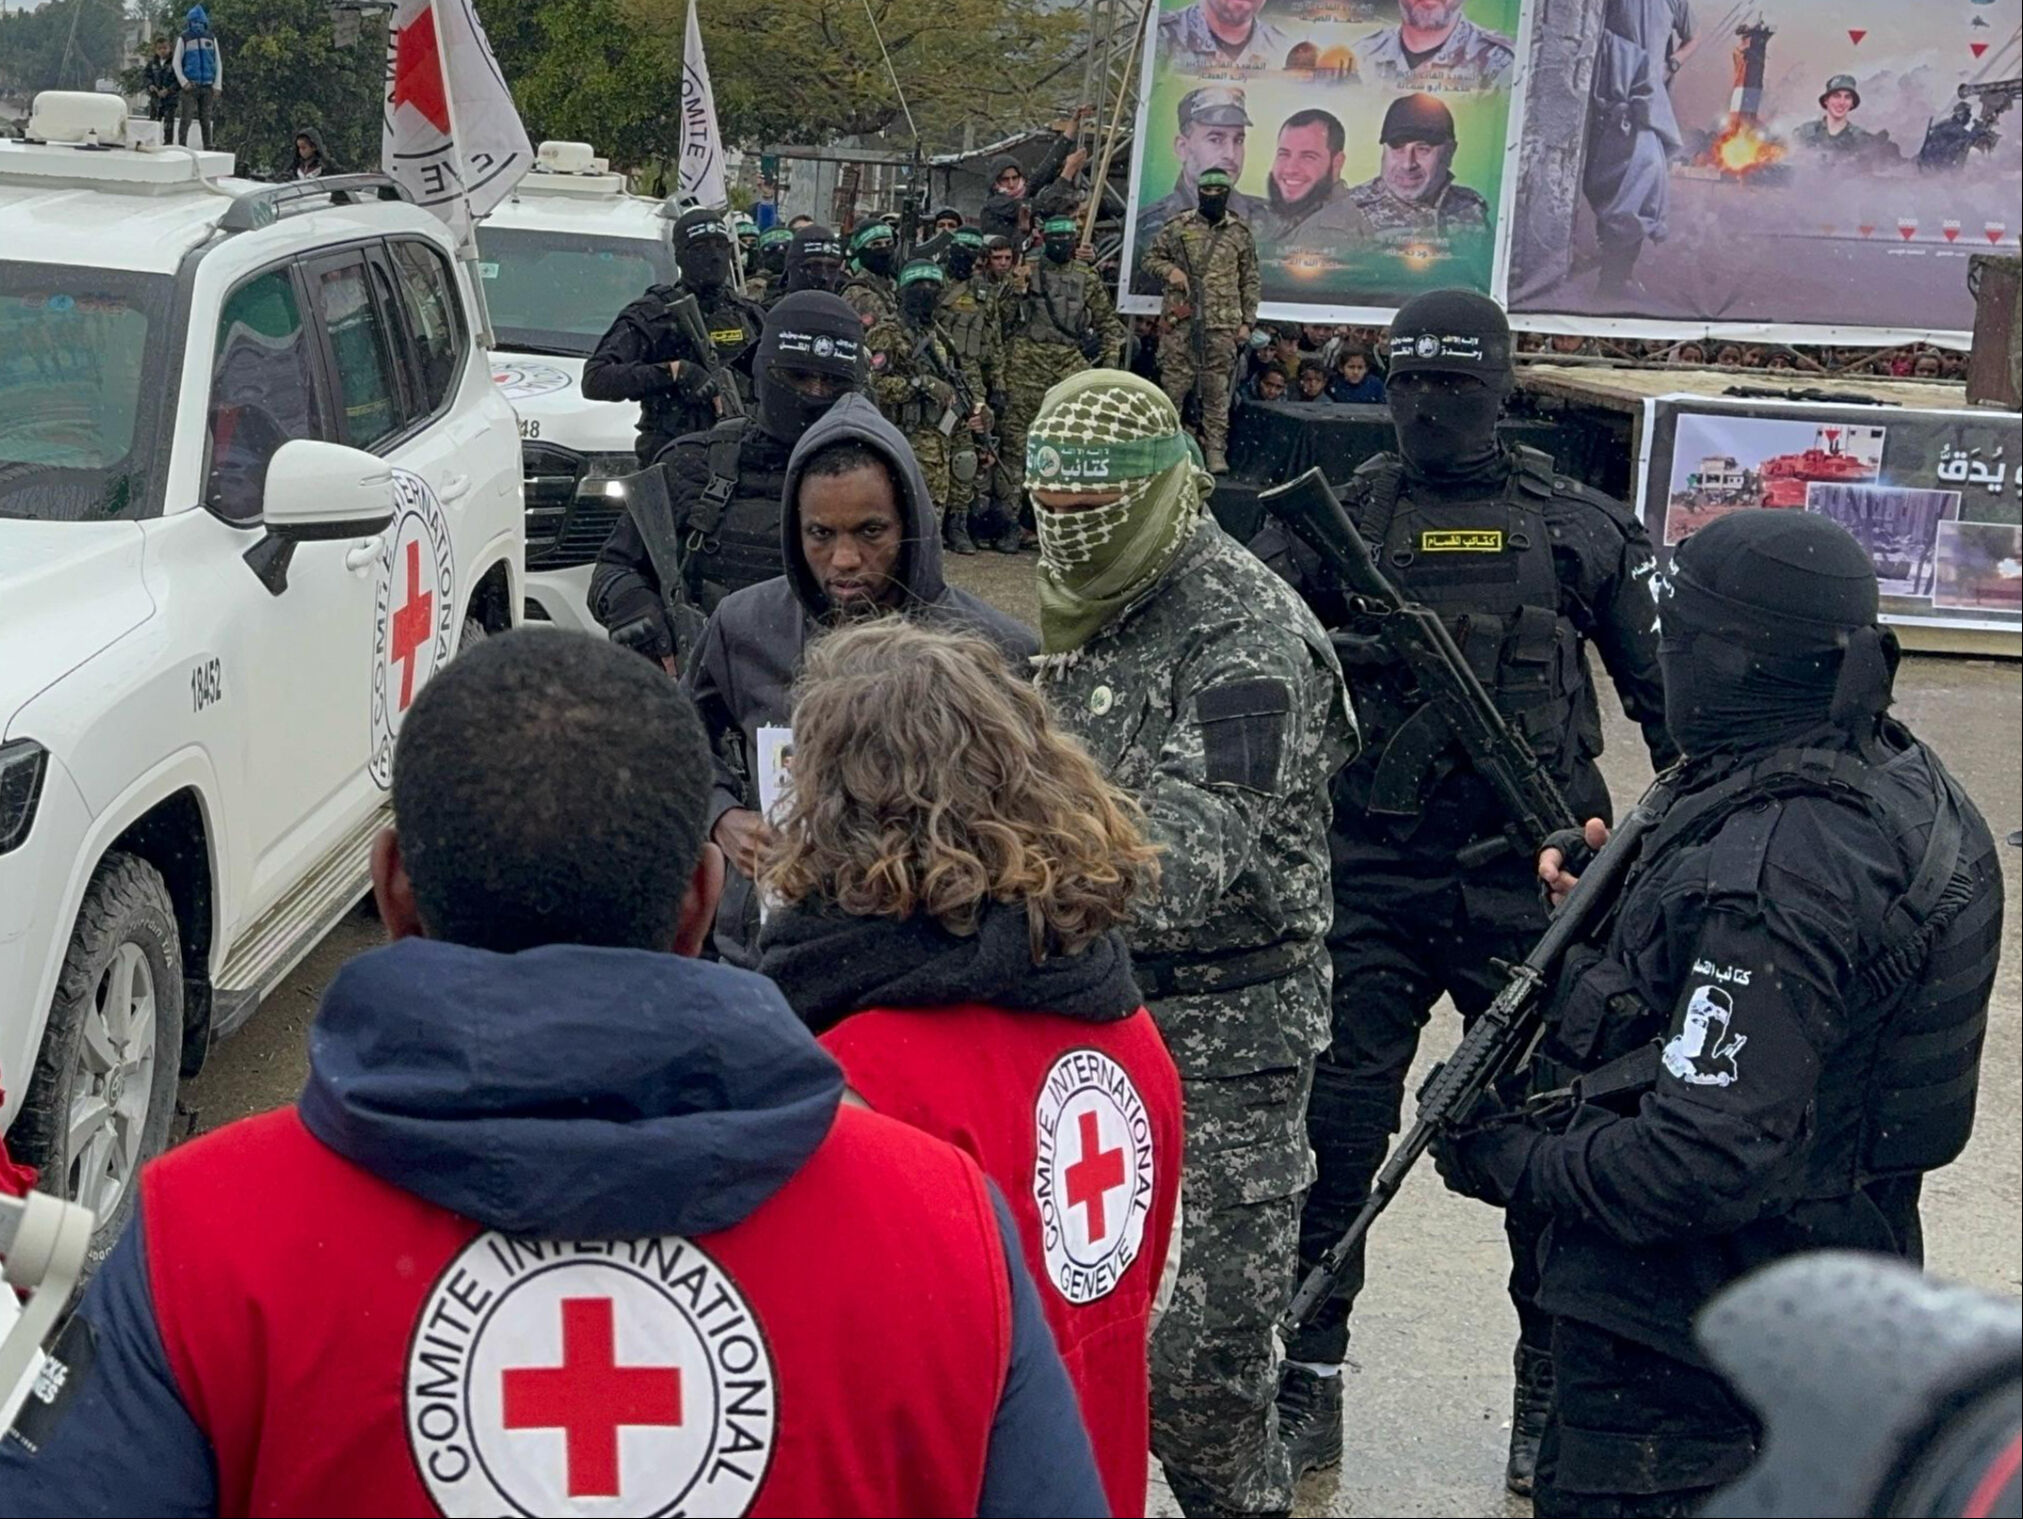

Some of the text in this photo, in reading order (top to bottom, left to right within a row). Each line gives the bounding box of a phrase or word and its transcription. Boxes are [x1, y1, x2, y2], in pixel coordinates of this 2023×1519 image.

[681, 79, 708, 159] OMITE
[191, 656, 222, 713] 18452
[1037, 1054, 1152, 1252] COMITE INTERNATIONAL
[1059, 1237, 1135, 1300] GENEVE
[416, 1267, 494, 1483] COMITE
